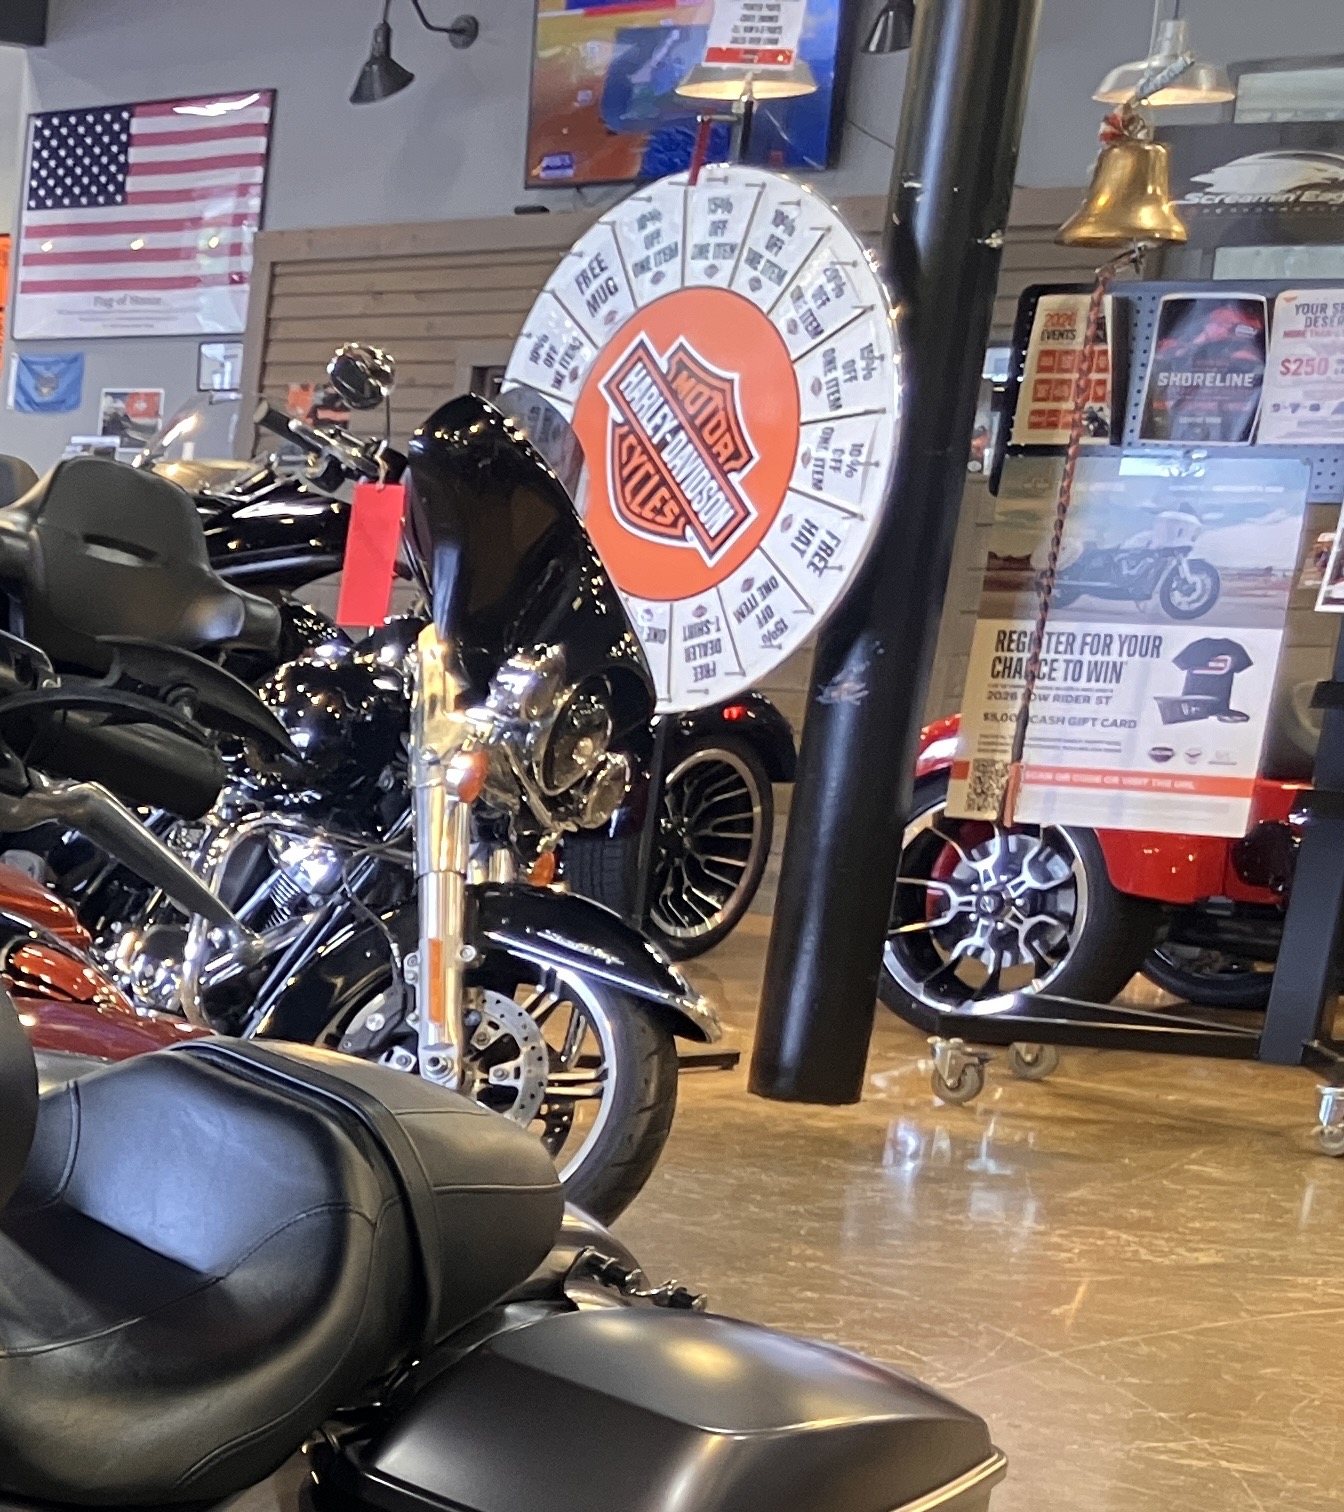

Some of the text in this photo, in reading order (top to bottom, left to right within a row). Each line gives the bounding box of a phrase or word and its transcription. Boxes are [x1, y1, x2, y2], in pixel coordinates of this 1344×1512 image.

[574, 252, 608, 296] FREE
[585, 276, 619, 318] MUG
[1295, 302, 1328, 316] YOUR
[822, 347, 843, 412] ONE ITEM
[841, 359, 859, 384] OFF
[1157, 372, 1255, 388] SHORELINE
[1279, 357, 1330, 377] $250
[672, 371, 736, 463] MOTOR
[619, 360, 734, 539] HARLEY-DAVIDSON
[829, 448, 846, 474] OFF
[844, 443, 865, 479] 10%
[621, 434, 680, 526] CYCLES
[811, 457, 826, 492] ITEM
[790, 518, 820, 559] HAT
[807, 529, 842, 579] FREE
[733, 575, 780, 625] ONE ITEM
[682, 615, 721, 643] T-SHIRT
[755, 604, 775, 630] OFF
[994, 629, 1163, 659] REGITER FOR YOUR
[692, 660, 717, 683] FREE
[990, 656, 1124, 684] CHACE TO WIN
[1052, 694, 1091, 706] RIDER
[1095, 695, 1114, 706] ST
[1028, 713, 1066, 726] CASH
[1067, 716, 1098, 728] GIFT
[1100, 717, 1138, 730] CARD
